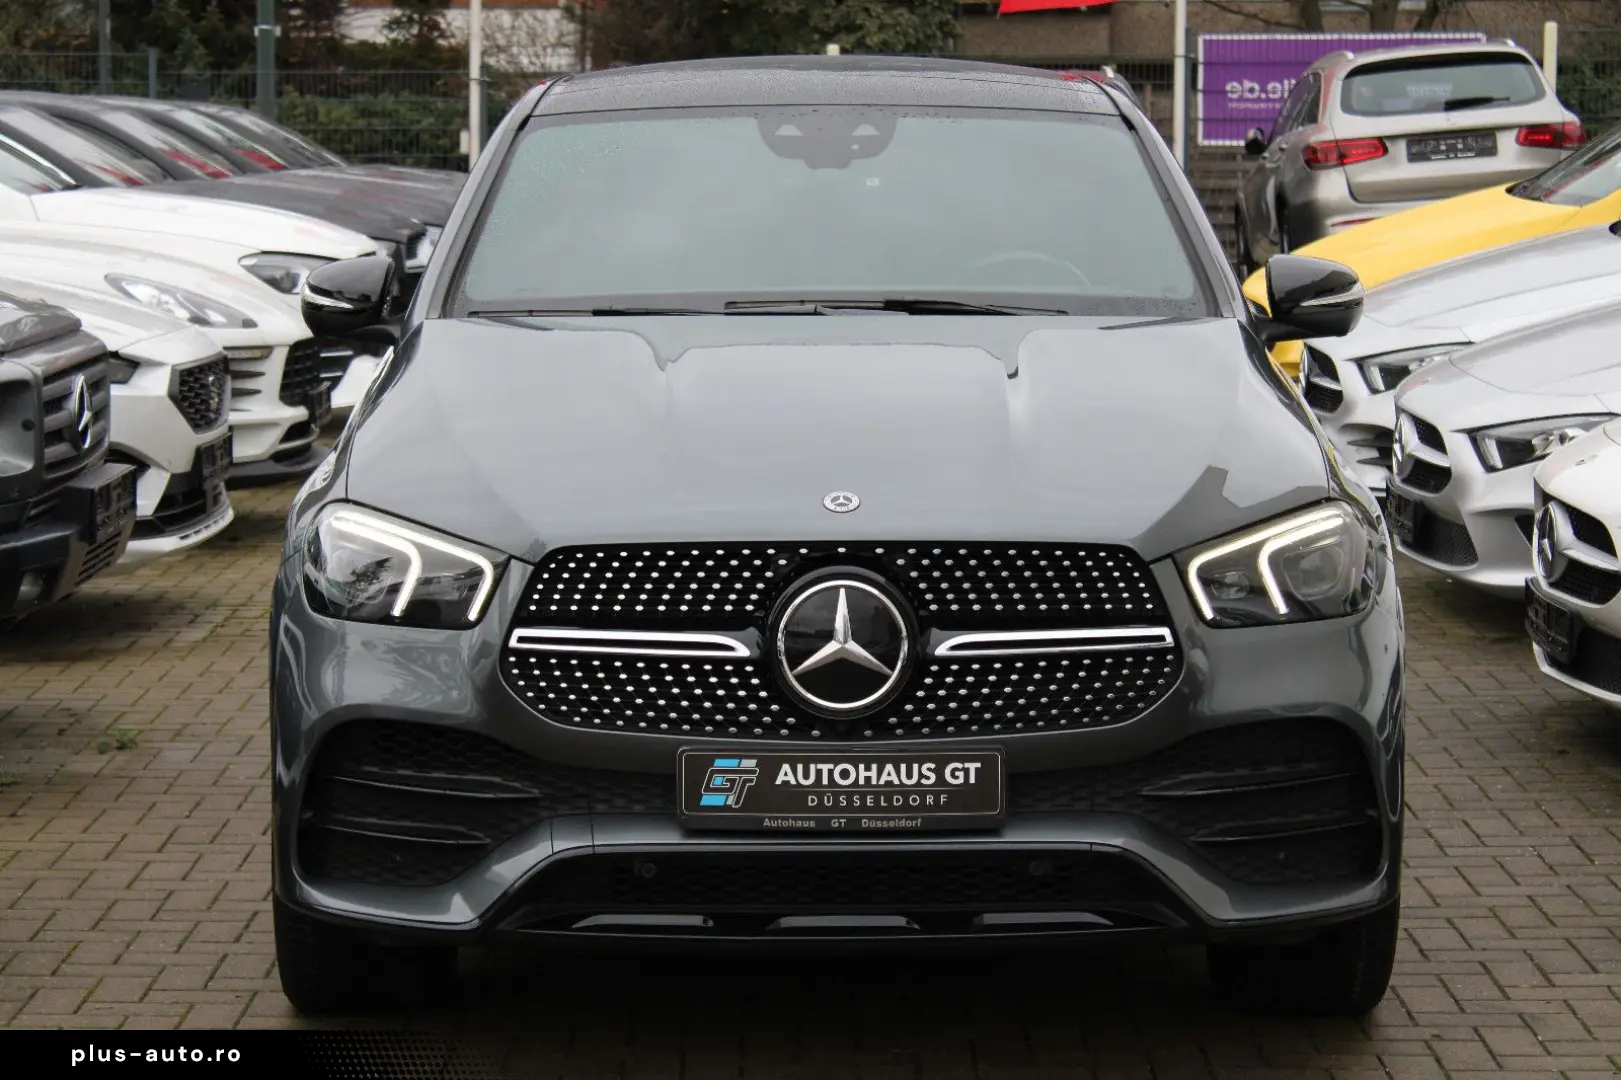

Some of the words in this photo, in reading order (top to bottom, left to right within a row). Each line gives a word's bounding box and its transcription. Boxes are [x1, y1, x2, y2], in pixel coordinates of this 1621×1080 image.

[775, 763, 936, 785] AUTOHAUS
[944, 763, 982, 785] GT
[807, 792, 949, 807] DÜSSELDORF
[763, 817, 816, 829] Autohaus
[830, 817, 847, 829] GT
[861, 817, 923, 829] Düsseldorf
